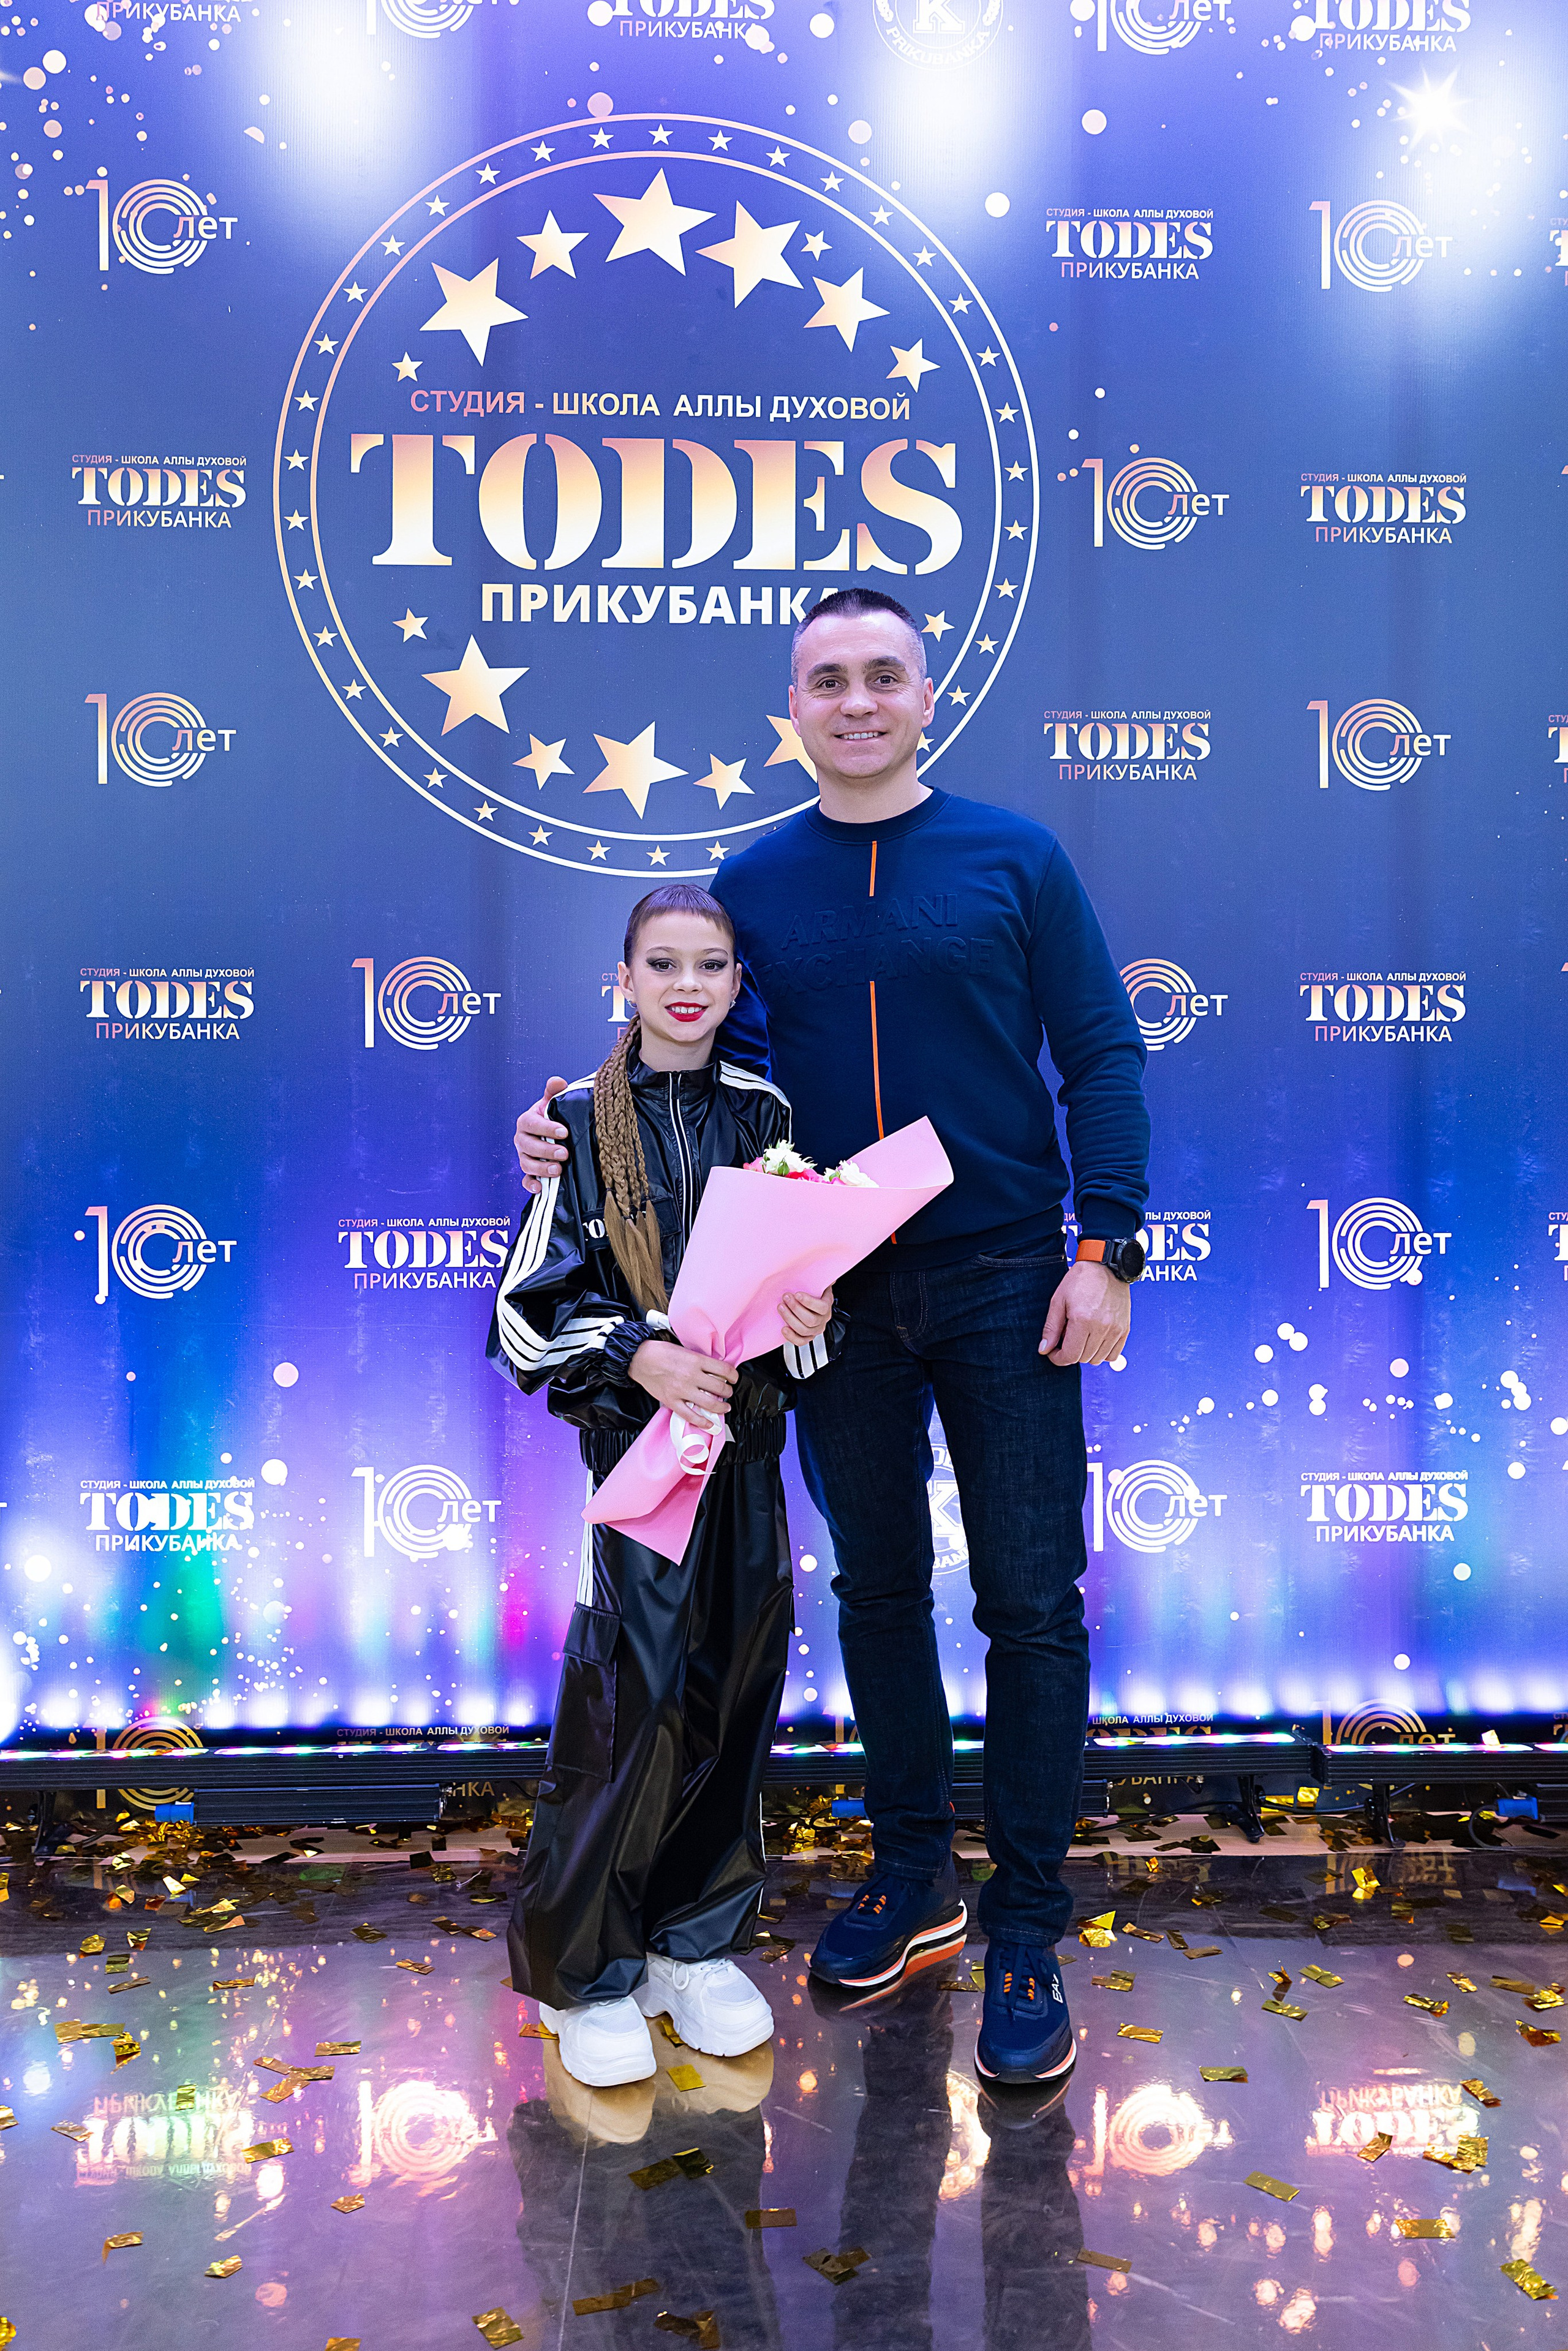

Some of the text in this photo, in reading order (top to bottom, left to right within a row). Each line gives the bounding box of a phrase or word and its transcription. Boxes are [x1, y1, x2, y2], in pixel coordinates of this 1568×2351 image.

[620, 20, 757, 39] ПРИКУБАНК
[886, 25, 990, 65] PRIKUBANKA
[1319, 33, 1457, 51] ПРИКУБАНКА
[1047, 208, 1084, 217] СТУДИЯ
[1166, 208, 1213, 219] ДУХОВОЙ
[173, 214, 238, 240] лет
[1046, 221, 1213, 259] TODES
[1392, 234, 1453, 259] лет
[1061, 262, 1199, 279] ПРИКУБАНКА
[410, 390, 524, 417] СТУДИЯ
[552, 392, 660, 416] ШКОЛА
[673, 394, 761, 418] АЛЛЫ
[769, 392, 910, 423] ДУХОВОЙ
[72, 455, 111, 464] СТУДИЯ
[197, 455, 246, 466] ДУХОВОЙ
[72, 467, 246, 507] TODES
[1301, 474, 1338, 482] СТУДИЯ
[1419, 473, 1466, 483] ДУХОВОЙ
[350, 433, 962, 575] TODES
[1168, 492, 1229, 516] лет
[1301, 486, 1466, 524] TODES
[88, 510, 231, 527] ПРИКУБАНКА
[1316, 527, 1452, 543] ПРИКУБАНКА
[481, 582, 839, 625] ПРИКУБАНК
[1163, 710, 1210, 720] ДУХОВОЙ
[172, 727, 236, 752] лет
[1044, 723, 1210, 760] TODES
[1390, 734, 1451, 757] лет
[1060, 764, 1196, 780] ПРИКУБАНКА
[781, 893, 959, 949] ARMANI
[80, 968, 119, 977] СТУДИЯ
[205, 967, 254, 978] ДУХОВОЙ
[760, 936, 995, 997] EXCHANGE
[1300, 973, 1338, 981] СТУДИЯ
[1419, 972, 1466, 983] ДУХОВОЙ
[80, 981, 254, 1019] TODES
[438, 990, 501, 1014] лет
[1167, 994, 1228, 1016] лет
[1300, 984, 1465, 1022] TODES
[97, 1023, 239, 1039] ПРИКУБАНКА
[1316, 1026, 1452, 1041] ПРИКУБАНКА
[339, 1219, 377, 1228] СТУДИЯ
[461, 1217, 510, 1228] ДУХОВОЙ
[1163, 1210, 1211, 1221] ДУХОВОЙ
[172, 1239, 237, 1264] лет
[339, 1230, 508, 1269] TODES
[1390, 1232, 1452, 1256] лет
[355, 1272, 496, 1289] ПРИКУБАНКА
[1301, 1473, 1340, 1482] СТУДИЯ
[1388, 1472, 1418, 1481] АЛЛЫ
[1419, 1470, 1468, 1482] ДУХОВОЙ
[80, 1491, 255, 1531] TODES
[437, 1499, 501, 1524] лет
[1165, 1493, 1227, 1517] лет
[1300, 1483, 1468, 1522] TODES
[1316, 1525, 1454, 1542] ПРИКУБАНКА
[428, 1726, 458, 1735] АЛЛЫ
[1092, 1713, 1214, 1726] ШКОЛА АЛЛЫ ДУХОВОЙ
